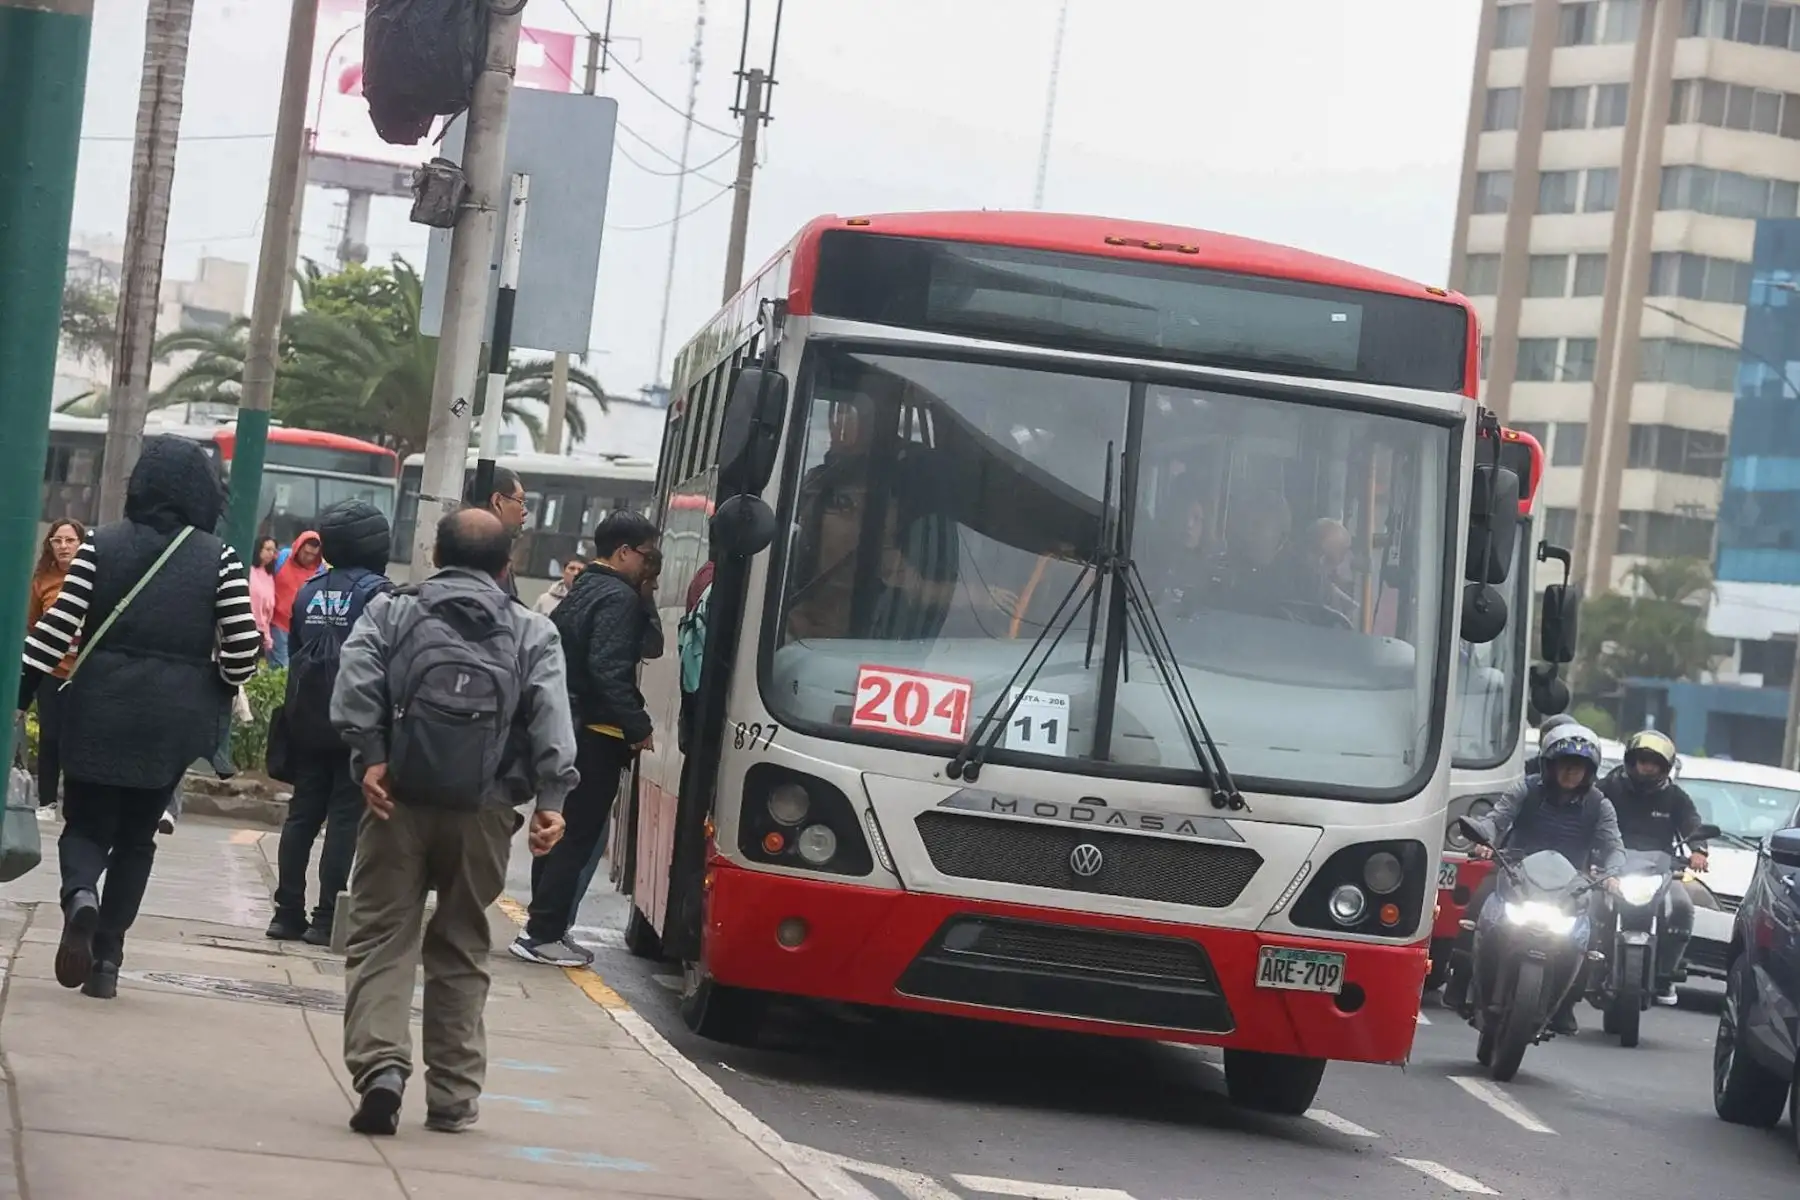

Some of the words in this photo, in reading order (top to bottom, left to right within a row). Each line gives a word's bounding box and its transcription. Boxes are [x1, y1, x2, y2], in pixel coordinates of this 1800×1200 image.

[305, 589, 353, 616] ATU
[855, 676, 967, 734] 204
[734, 721, 779, 751] 897
[1013, 716, 1058, 744] 11
[991, 796, 1199, 835] MODASA
[1260, 957, 1340, 988] ARE-709
